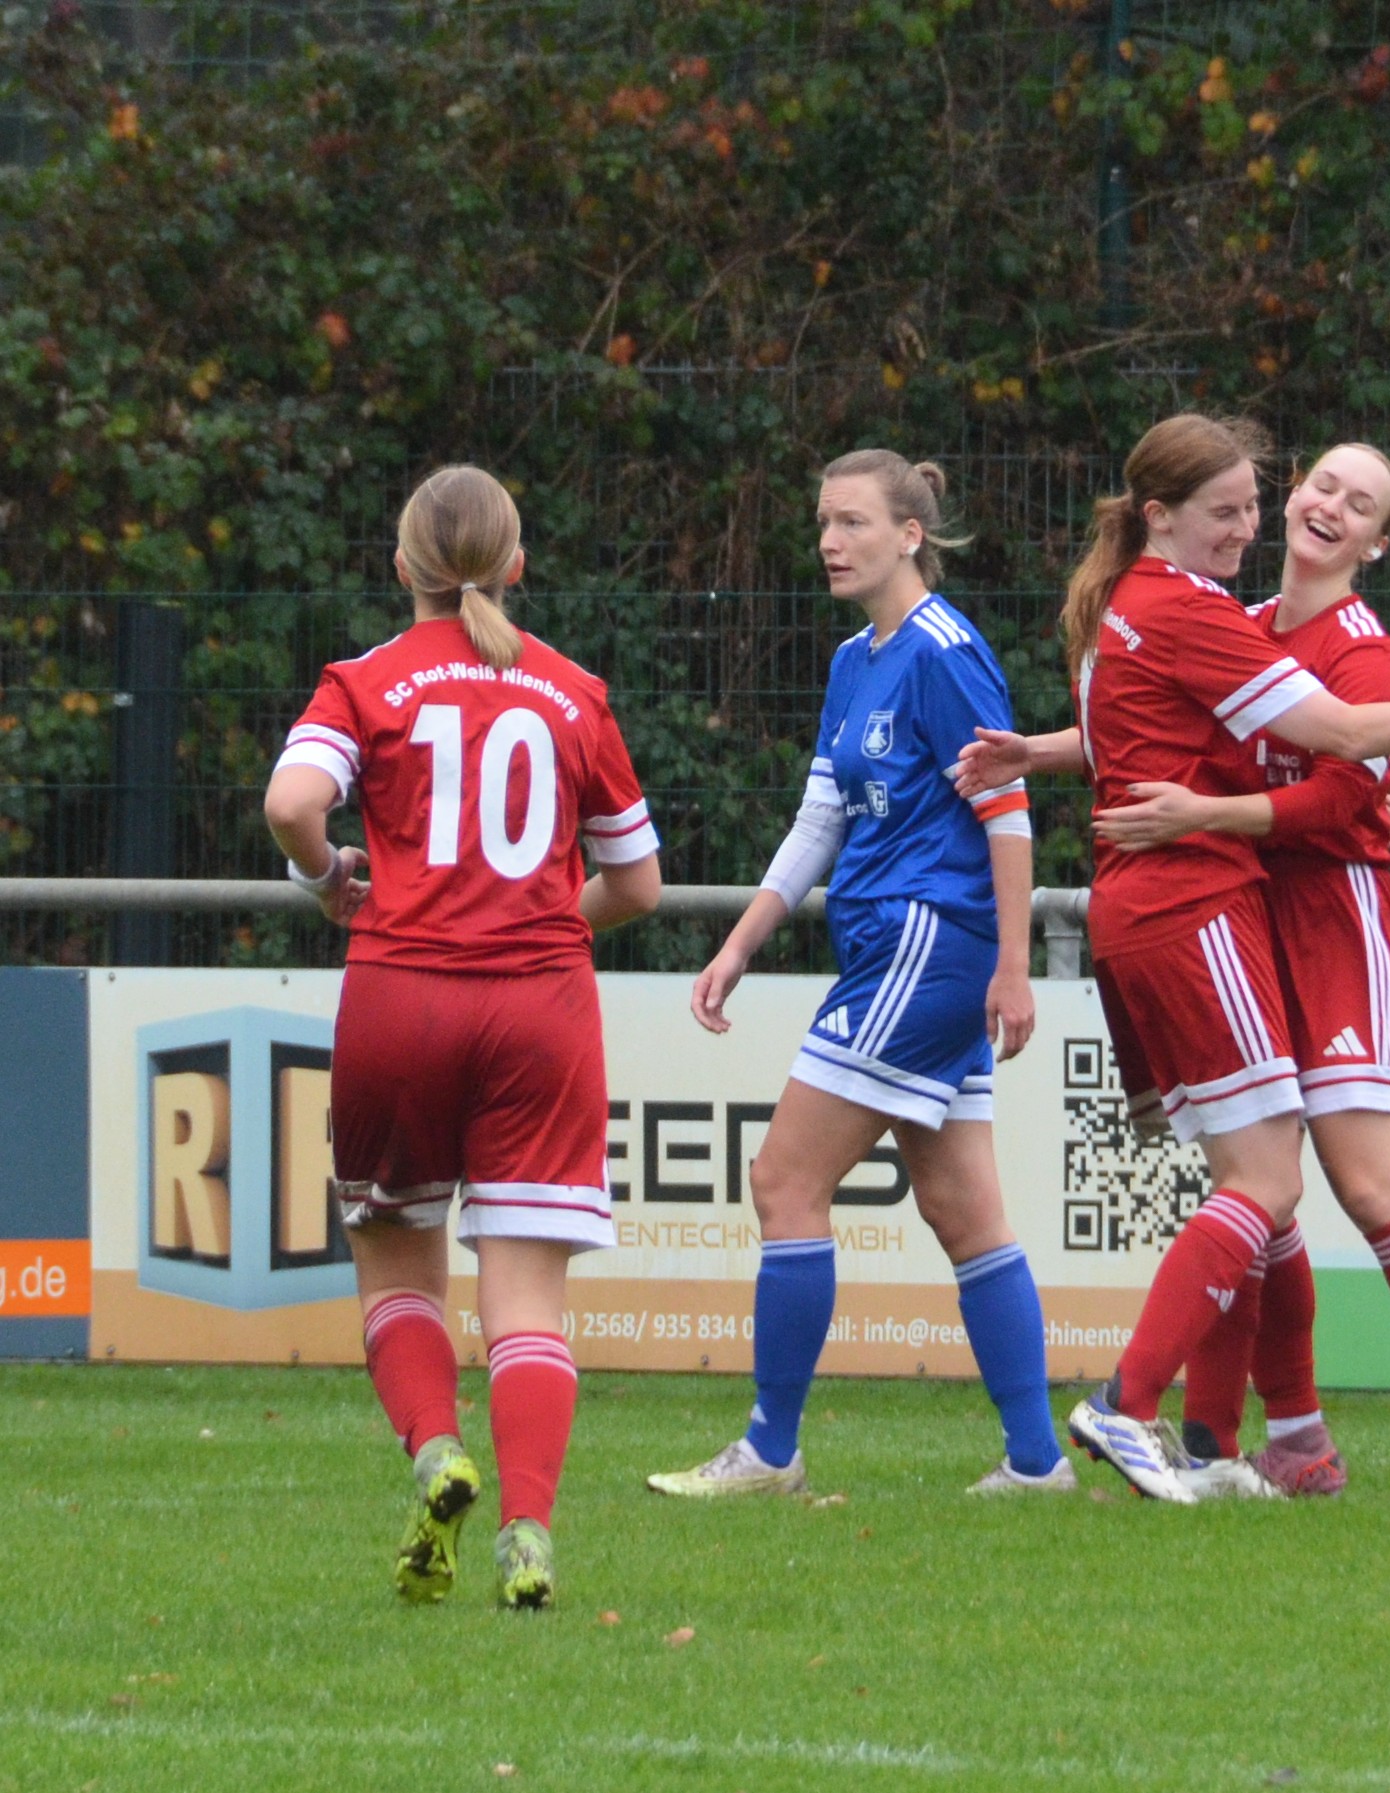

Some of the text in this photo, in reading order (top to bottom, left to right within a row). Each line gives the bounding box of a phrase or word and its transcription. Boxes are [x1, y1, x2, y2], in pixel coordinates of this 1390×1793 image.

[384, 662, 579, 721] SC Rot-Weiß Nienborg
[409, 703, 557, 879] 10
[833, 1224, 904, 1251] MBH
[0, 1255, 66, 1308] .de
[458, 1310, 482, 1336] Te
[583, 1311, 647, 1341] 2568/
[654, 1313, 691, 1338] 935
[698, 1314, 737, 1338] 834
